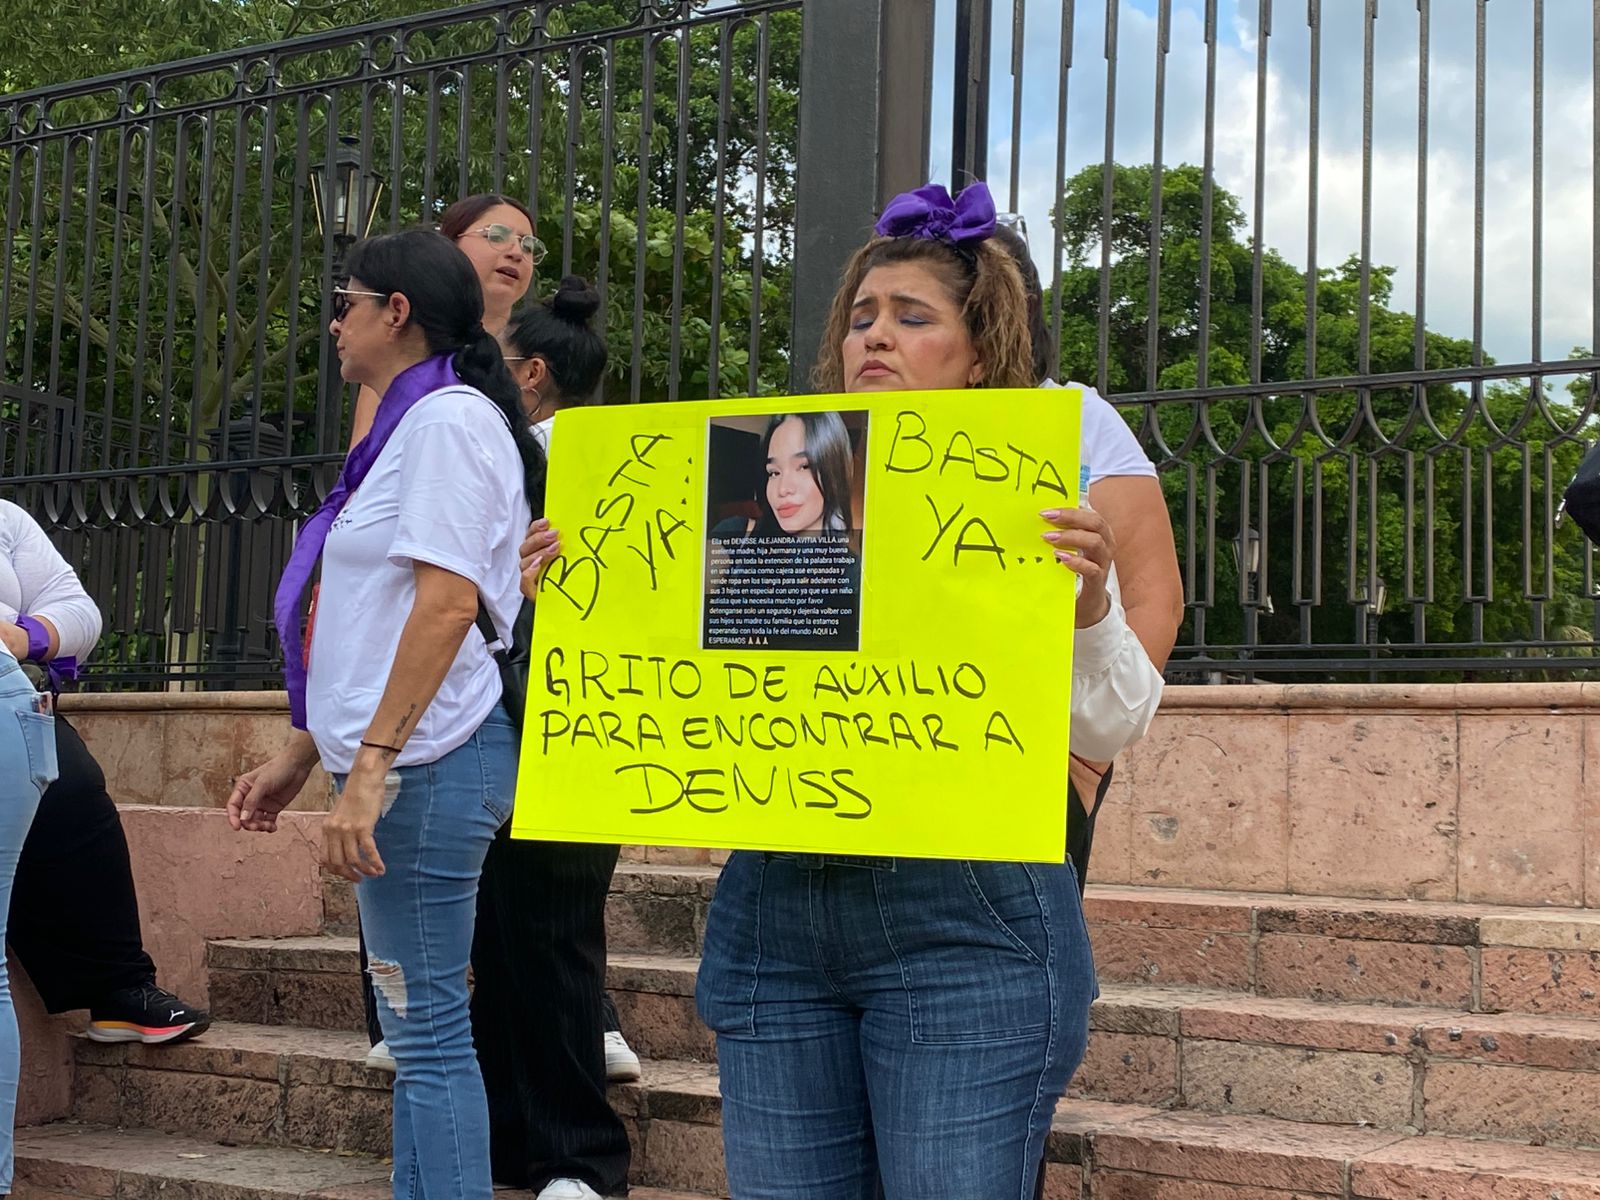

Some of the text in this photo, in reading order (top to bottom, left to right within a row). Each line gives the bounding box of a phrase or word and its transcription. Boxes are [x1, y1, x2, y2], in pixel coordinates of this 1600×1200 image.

[885, 411, 1068, 500] BASTA
[540, 433, 673, 621] BASTA
[766, 608, 791, 616] segundo
[545, 647, 702, 706] GRITO
[723, 663, 788, 702] DE
[540, 709, 1024, 756] PARA ENCONTRAR A
[614, 762, 872, 819] DENISS
